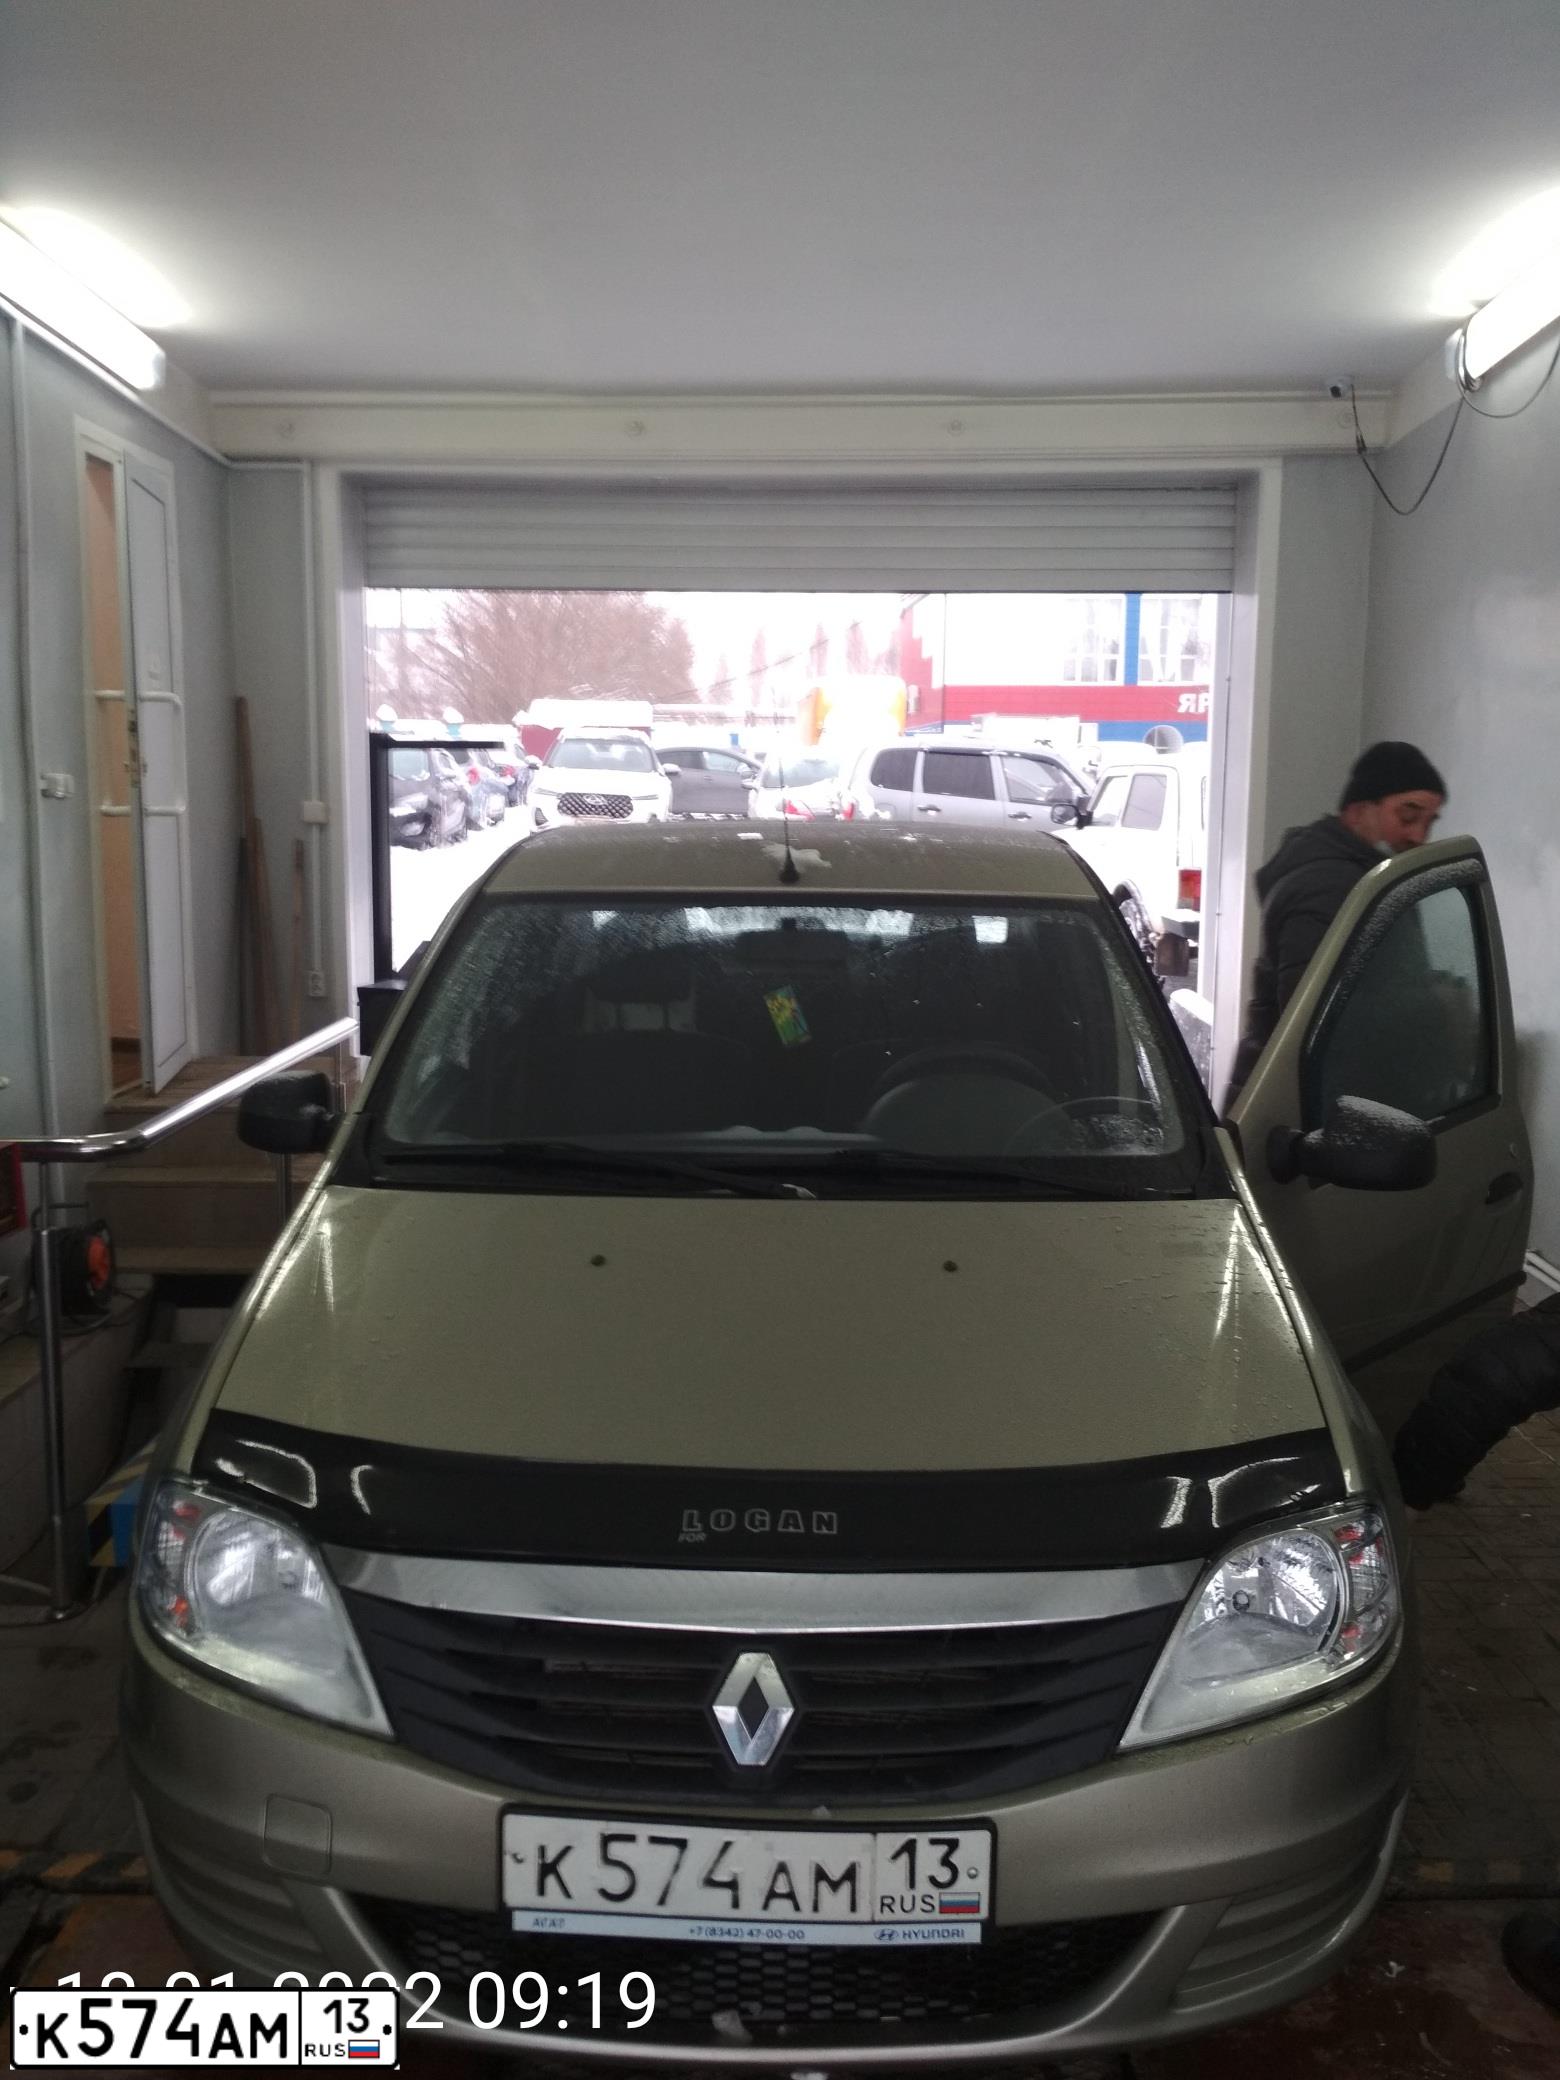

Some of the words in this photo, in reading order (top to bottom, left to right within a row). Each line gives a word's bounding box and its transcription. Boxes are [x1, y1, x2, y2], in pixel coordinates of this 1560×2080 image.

[682, 1508, 838, 1535] LOGAN
[889, 1837, 961, 1890] 13
[879, 1894, 936, 1914] RUS
[902, 1929, 966, 1940] HYUNDAI
